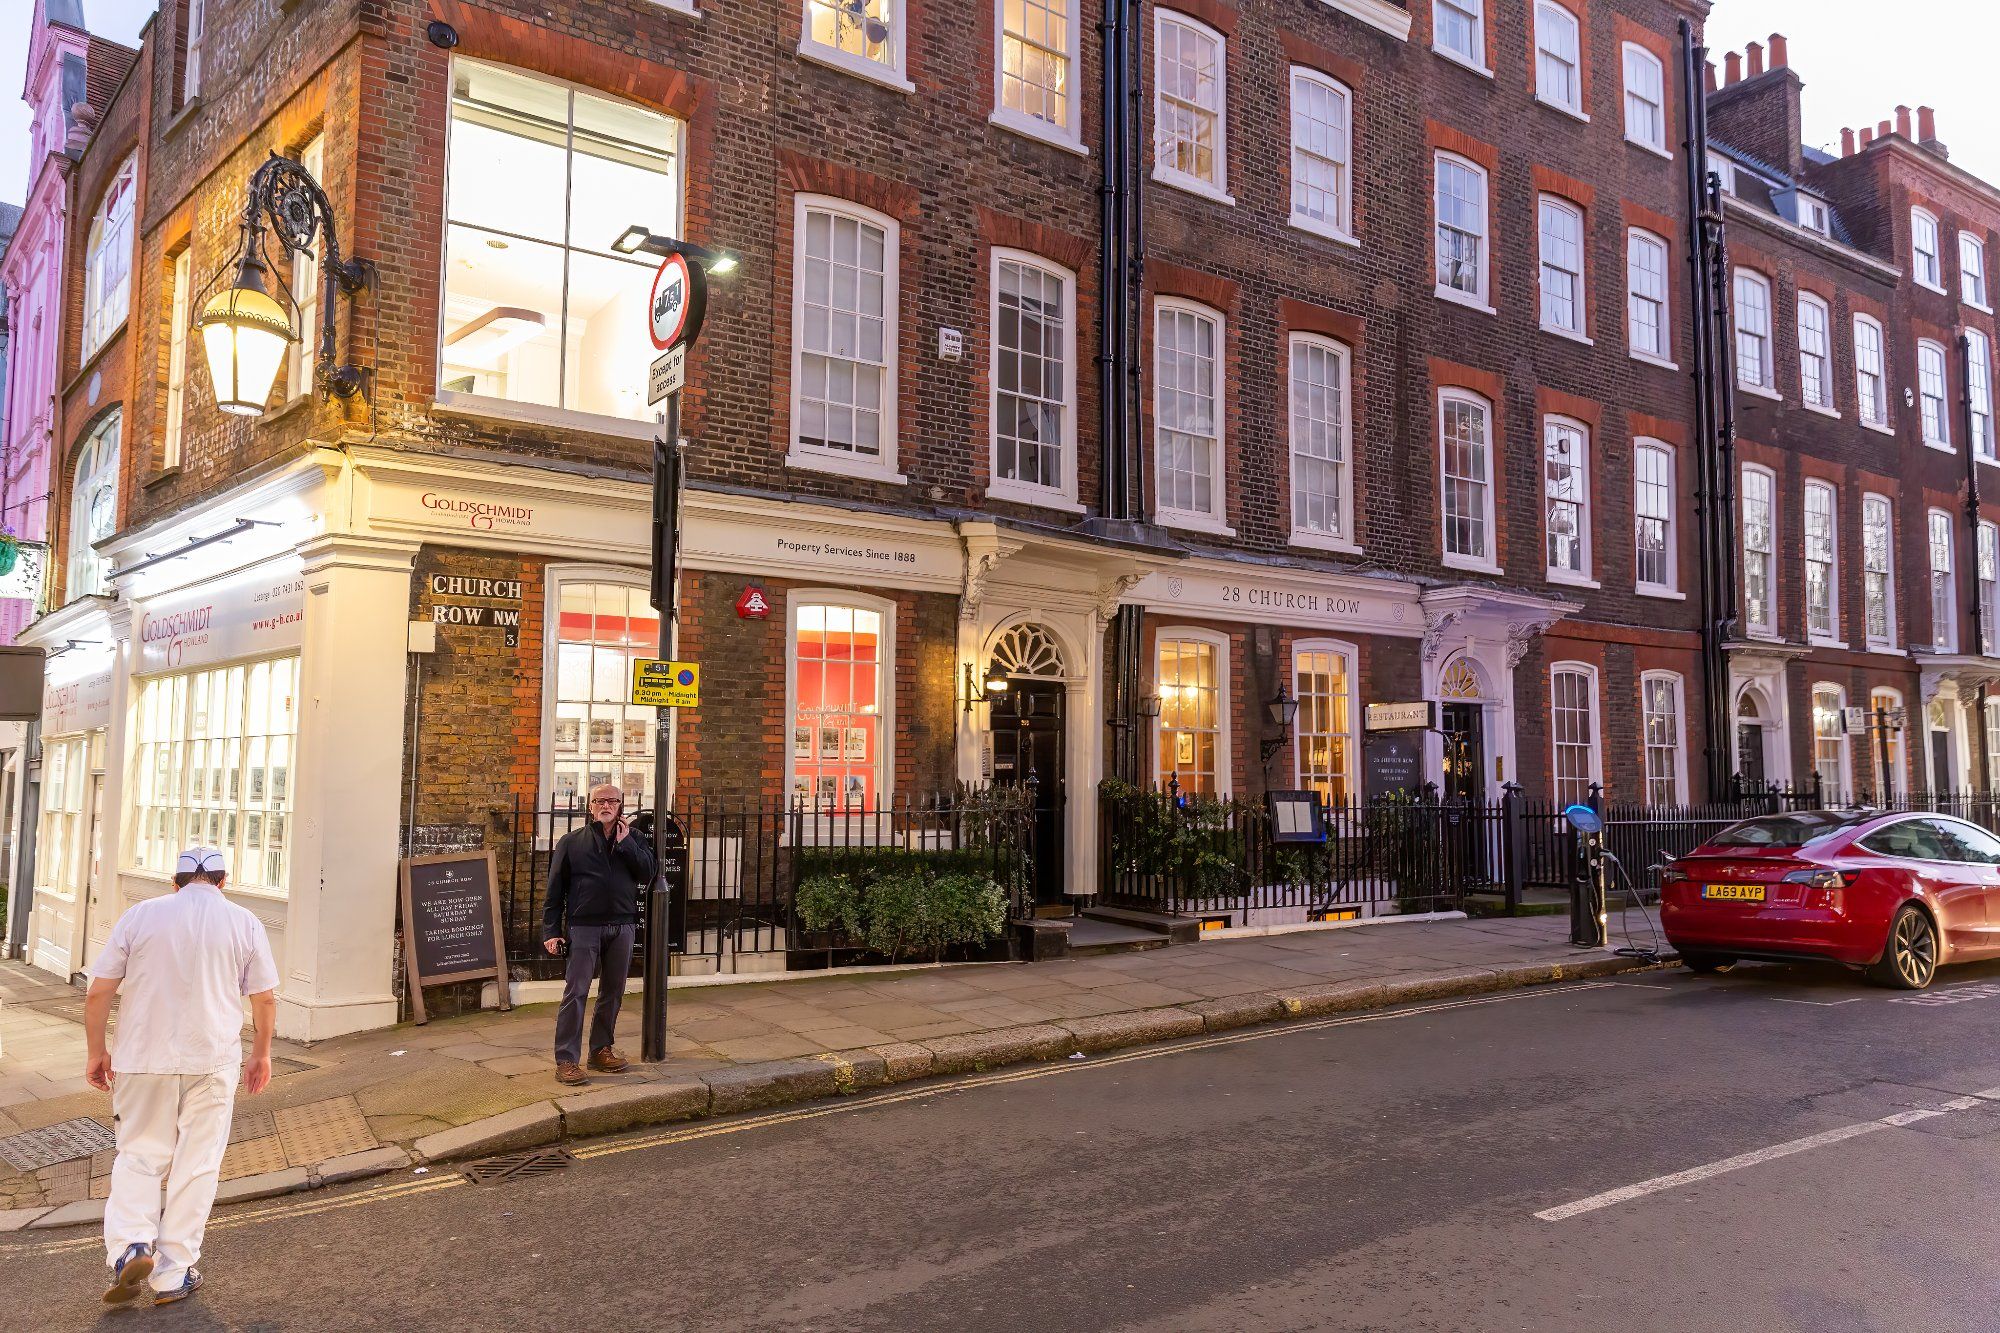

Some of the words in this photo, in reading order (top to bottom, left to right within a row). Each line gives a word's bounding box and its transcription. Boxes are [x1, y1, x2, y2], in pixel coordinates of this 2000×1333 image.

[652, 358, 673, 381] Except
[673, 353, 683, 367] for
[656, 374, 677, 394] access
[496, 517, 532, 527] HOWLAND
[777, 538, 821, 555] Property
[824, 543, 863, 558] Services
[866, 548, 890, 561] Since
[894, 551, 916, 563] 1888
[433, 575, 522, 599] CHURCH
[1222, 585, 1241, 602] 28
[1248, 588, 1318, 611] CHURCH
[1326, 597, 1360, 614] ROW
[433, 605, 484, 625] ROW
[184, 633, 209, 648] HOWLAND
[640, 696, 669, 704] Midnight
[668, 691, 697, 699] Midnight
[1368, 710, 1426, 721] RESTAURANT
[1708, 886, 1737, 897] LA69
[1739, 887, 1762, 898] AYP
[433, 898, 447, 906] ARE
[433, 909, 467, 918] SATURDAY
[440, 904, 453, 912] DAY
[440, 916, 467, 924] SUNDAY
[425, 928, 450, 936] TAKING
[451, 924, 484, 933] BOOKINGS
[442, 931, 465, 940] LUNCH
[465, 930, 483, 938] ONLY
